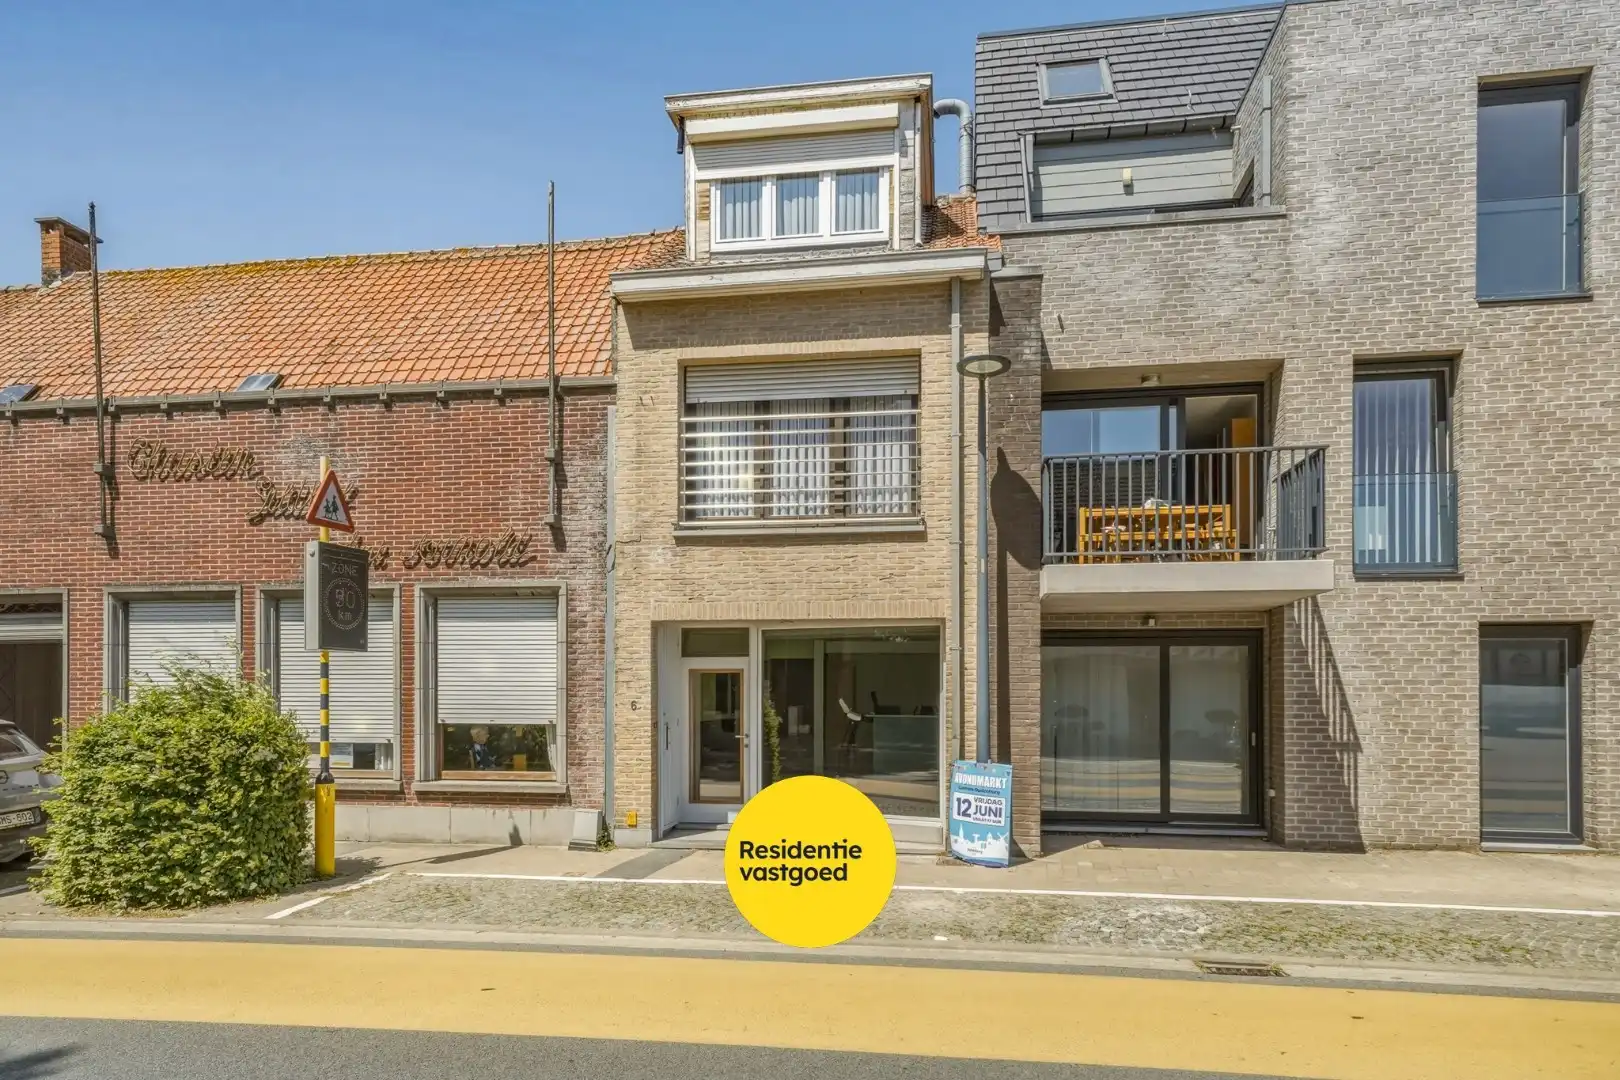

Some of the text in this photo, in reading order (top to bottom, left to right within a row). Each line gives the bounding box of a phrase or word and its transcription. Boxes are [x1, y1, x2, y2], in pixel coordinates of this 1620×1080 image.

[331, 561, 359, 576] ZONE
[630, 701, 638, 711] 6
[974, 796, 1003, 806] VRIJDAG
[956, 797, 1003, 818] 12 JUNI
